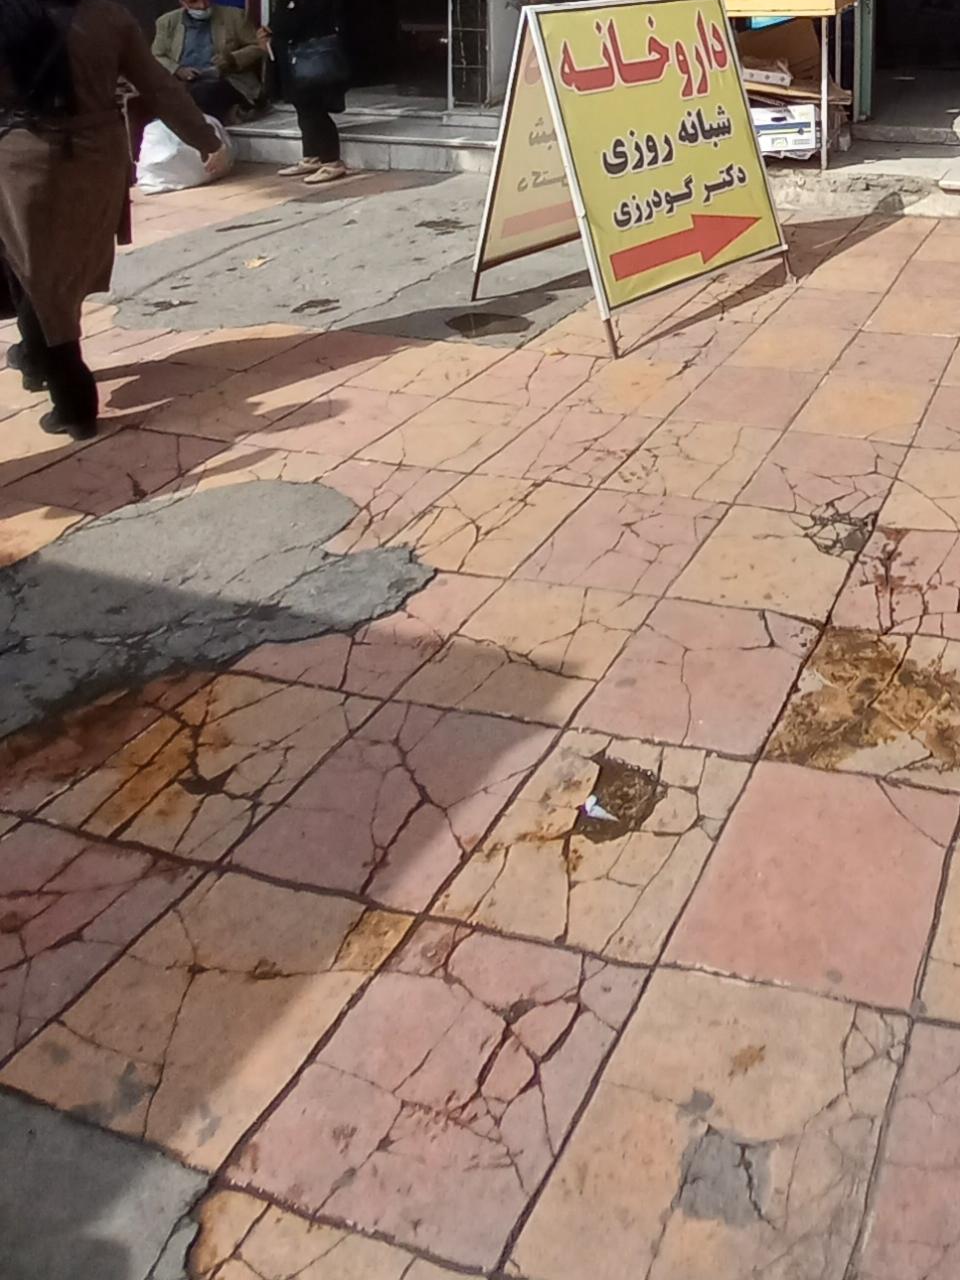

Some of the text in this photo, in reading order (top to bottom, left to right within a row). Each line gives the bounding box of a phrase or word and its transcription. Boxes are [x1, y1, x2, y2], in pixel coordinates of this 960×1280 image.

[560, 10, 729, 98] داروخانه
[602, 129, 673, 175] روزی
[677, 106, 732, 149] شبانه
[613, 164, 747, 228] دکتر گودرزی
